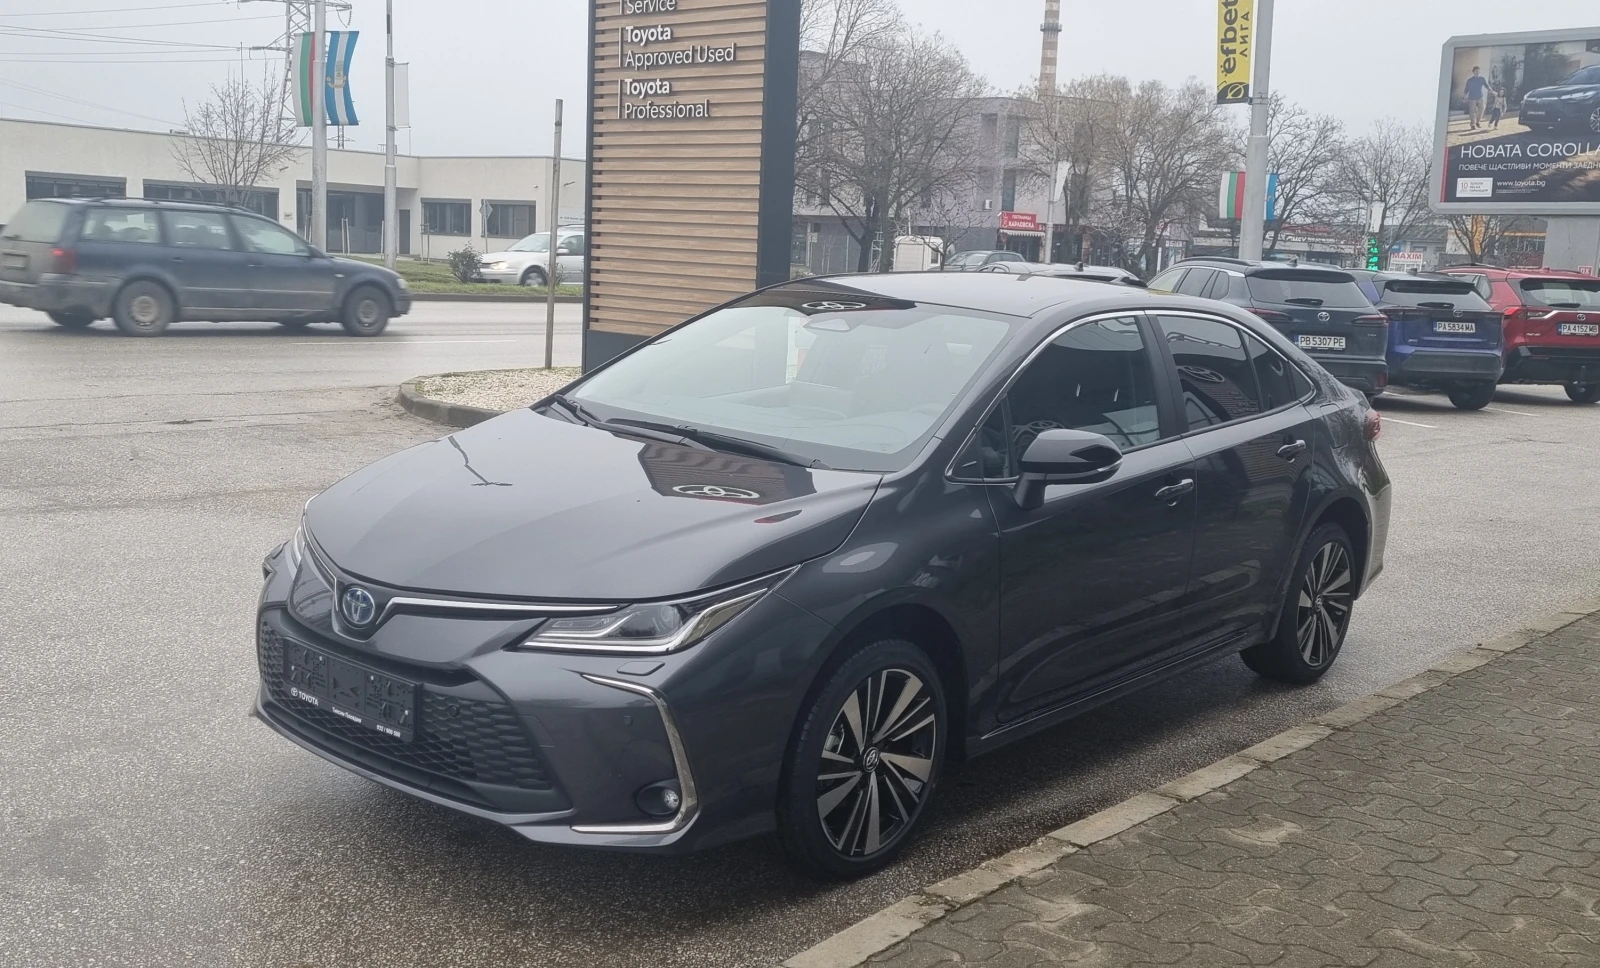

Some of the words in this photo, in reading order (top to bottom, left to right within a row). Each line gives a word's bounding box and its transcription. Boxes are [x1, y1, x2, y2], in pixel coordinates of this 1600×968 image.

[626, 0, 676, 14] Service
[625, 25, 671, 46] Toyota
[625, 45, 693, 70] Approved
[697, 42, 735, 63] Used
[624, 79, 670, 98] Toyota
[624, 99, 709, 119] Professional
[1460, 144, 1522, 159] НОВАТА
[1458, 163, 1487, 171] ПОВЕЧЕ
[1488, 162, 1532, 171] ЩАСТЛИВИ
[1532, 161, 1572, 170] МОМЕНТИ
[1572, 161, 1600, 169] ЗАЕДН
[1496, 180, 1546, 188] www.toyota.bg
[1392, 252, 1422, 260] MAXIM
[1300, 336, 1311, 346] PB
[1312, 337, 1332, 347] 5307
[1333, 337, 1344, 347] PE
[298, 690, 319, 707] TOYOTA
